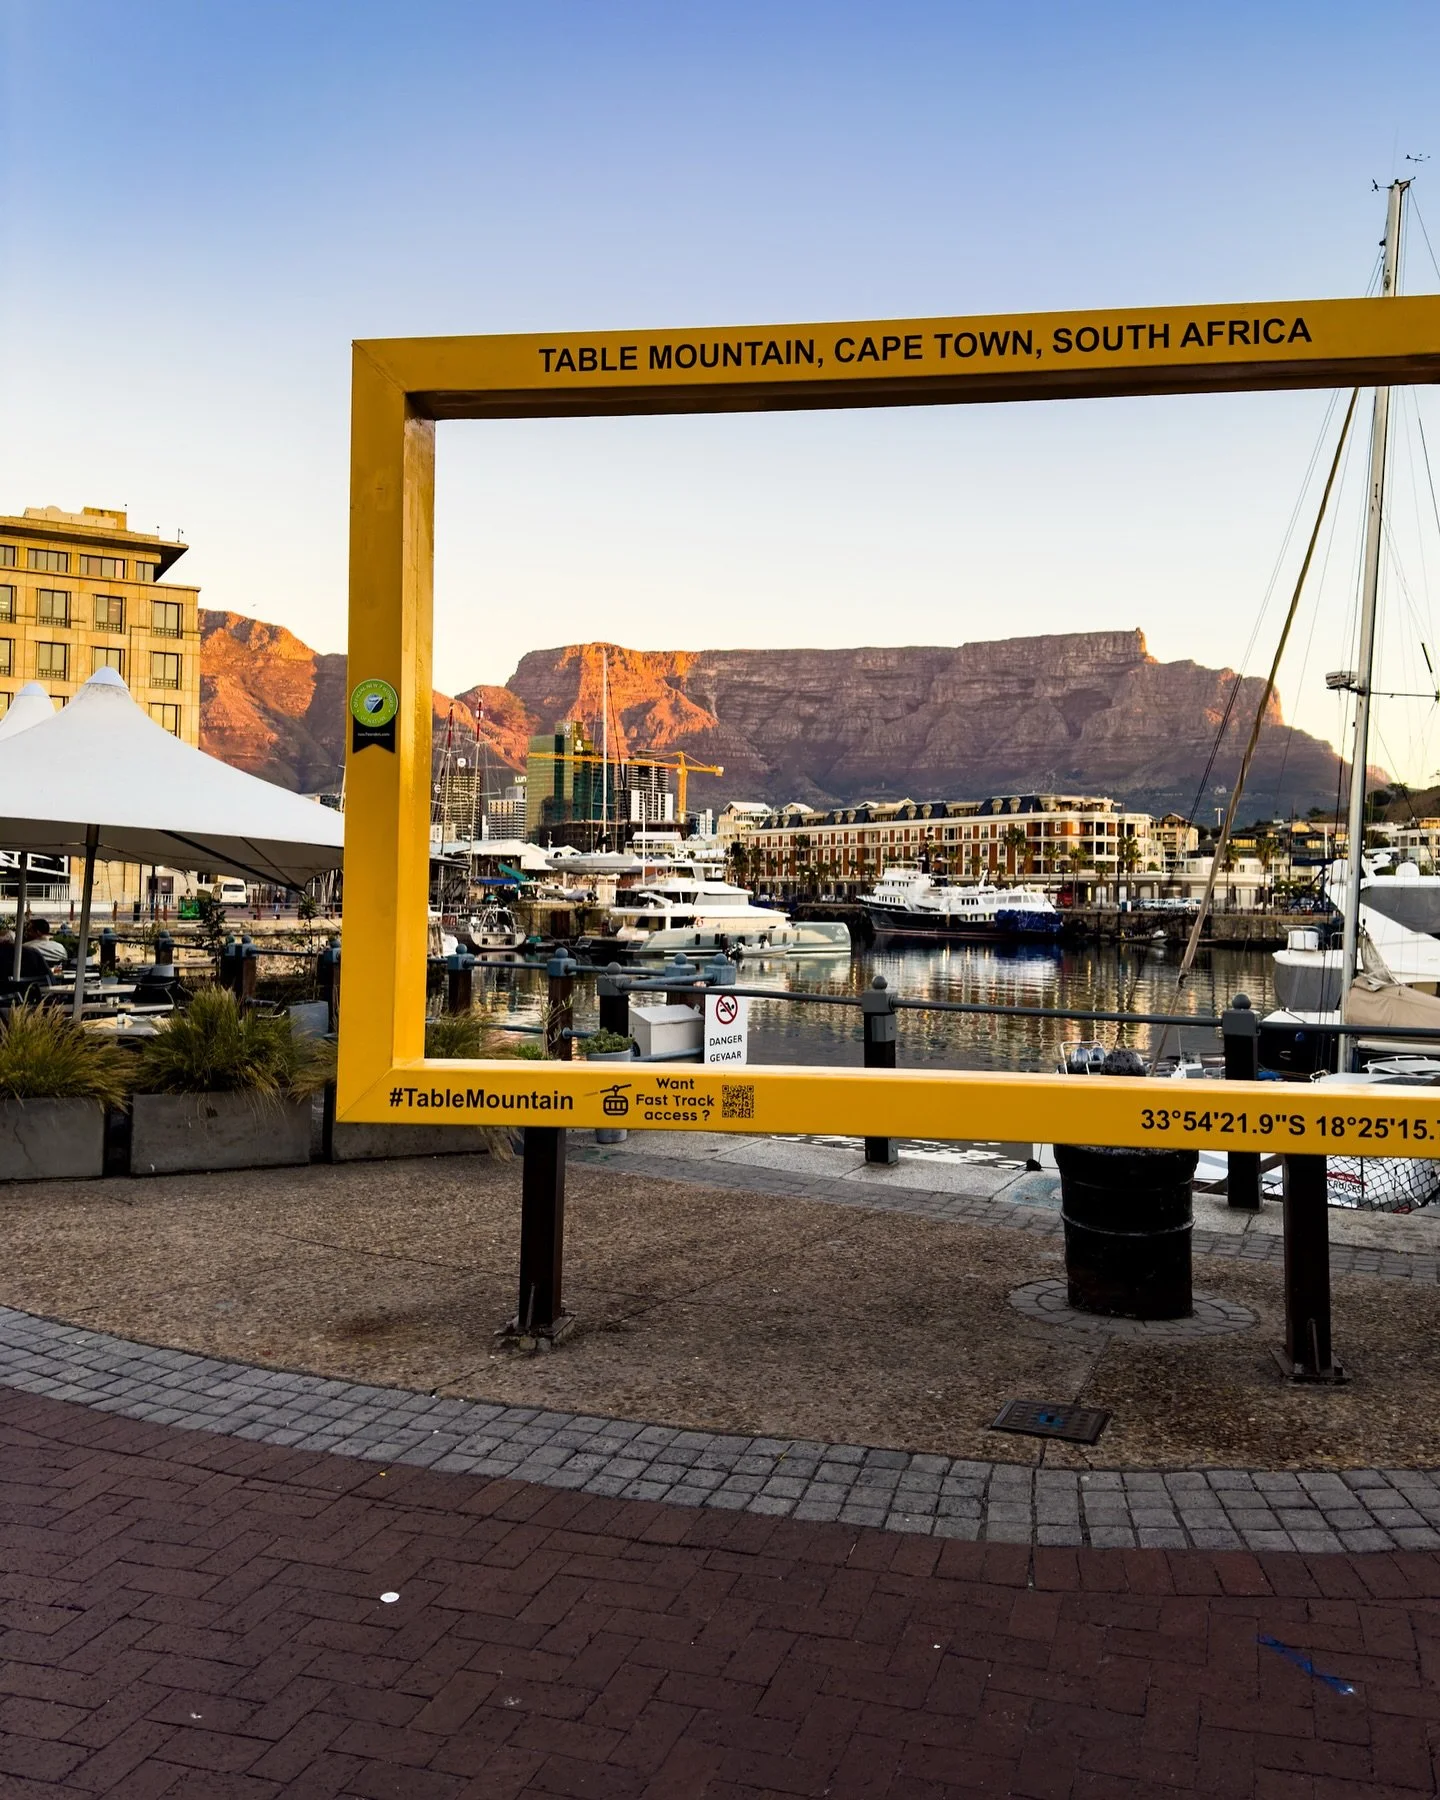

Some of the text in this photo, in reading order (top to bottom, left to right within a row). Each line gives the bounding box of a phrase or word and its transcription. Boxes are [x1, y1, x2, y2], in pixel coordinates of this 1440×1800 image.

[538, 317, 1313, 373] TABLE MOUNTAIN, CAPE TOWN, SOUTH AFRICA
[709, 1034, 743, 1046] DANGER
[709, 1050, 742, 1063] GEVAAR
[655, 1077, 695, 1090] Want
[389, 1087, 573, 1110] #TableMountain
[636, 1093, 715, 1107] Fast Track
[644, 1111, 698, 1121] access
[1141, 1109, 1440, 1140] 33°54'21.9"S 18°25'15.
